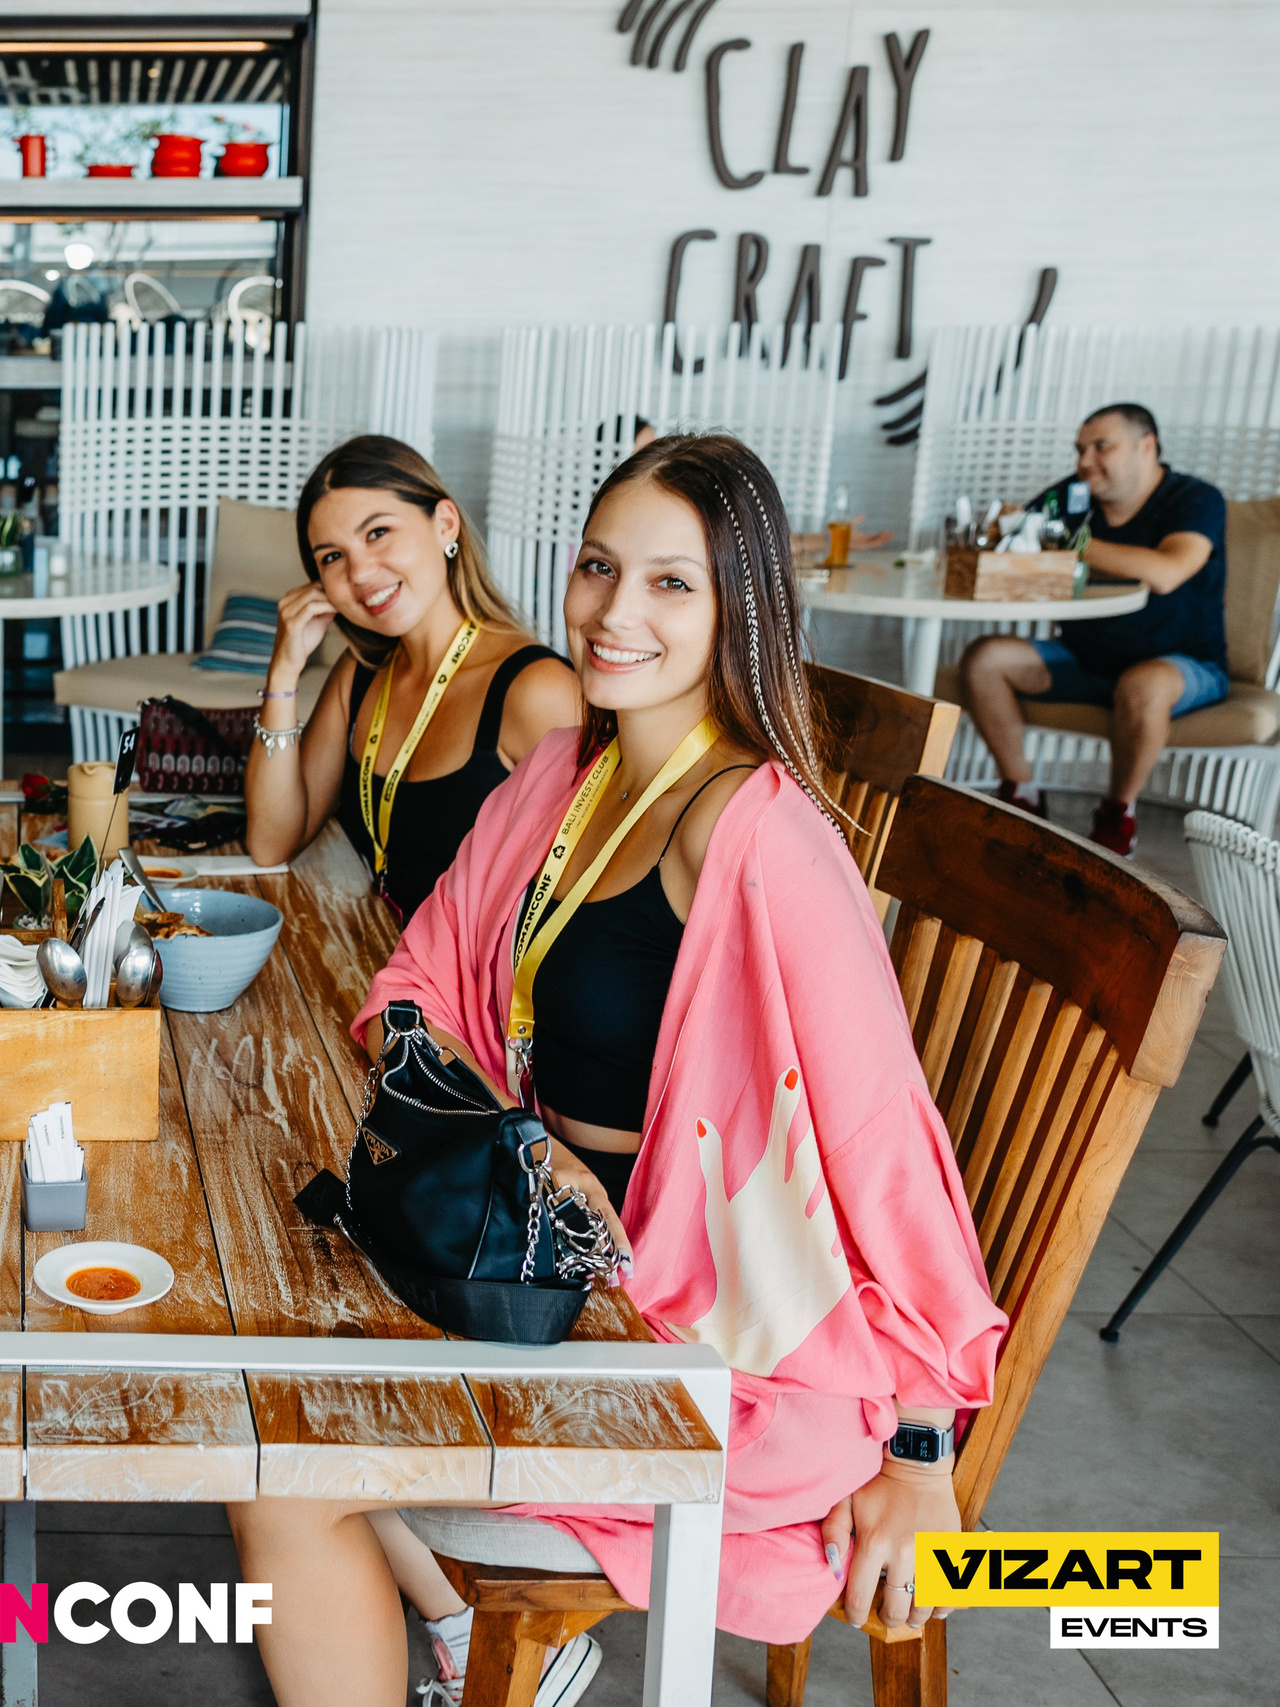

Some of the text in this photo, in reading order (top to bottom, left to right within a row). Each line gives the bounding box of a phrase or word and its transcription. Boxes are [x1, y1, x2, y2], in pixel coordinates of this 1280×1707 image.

[706, 29, 931, 197] CLAY
[663, 229, 933, 381] CRAFT
[452, 621, 477, 664] ANCONF
[122, 733, 136, 754] 54
[561, 755, 609, 835] BALI INVEST CLUB
[514, 873, 552, 968] WOMANCONF
